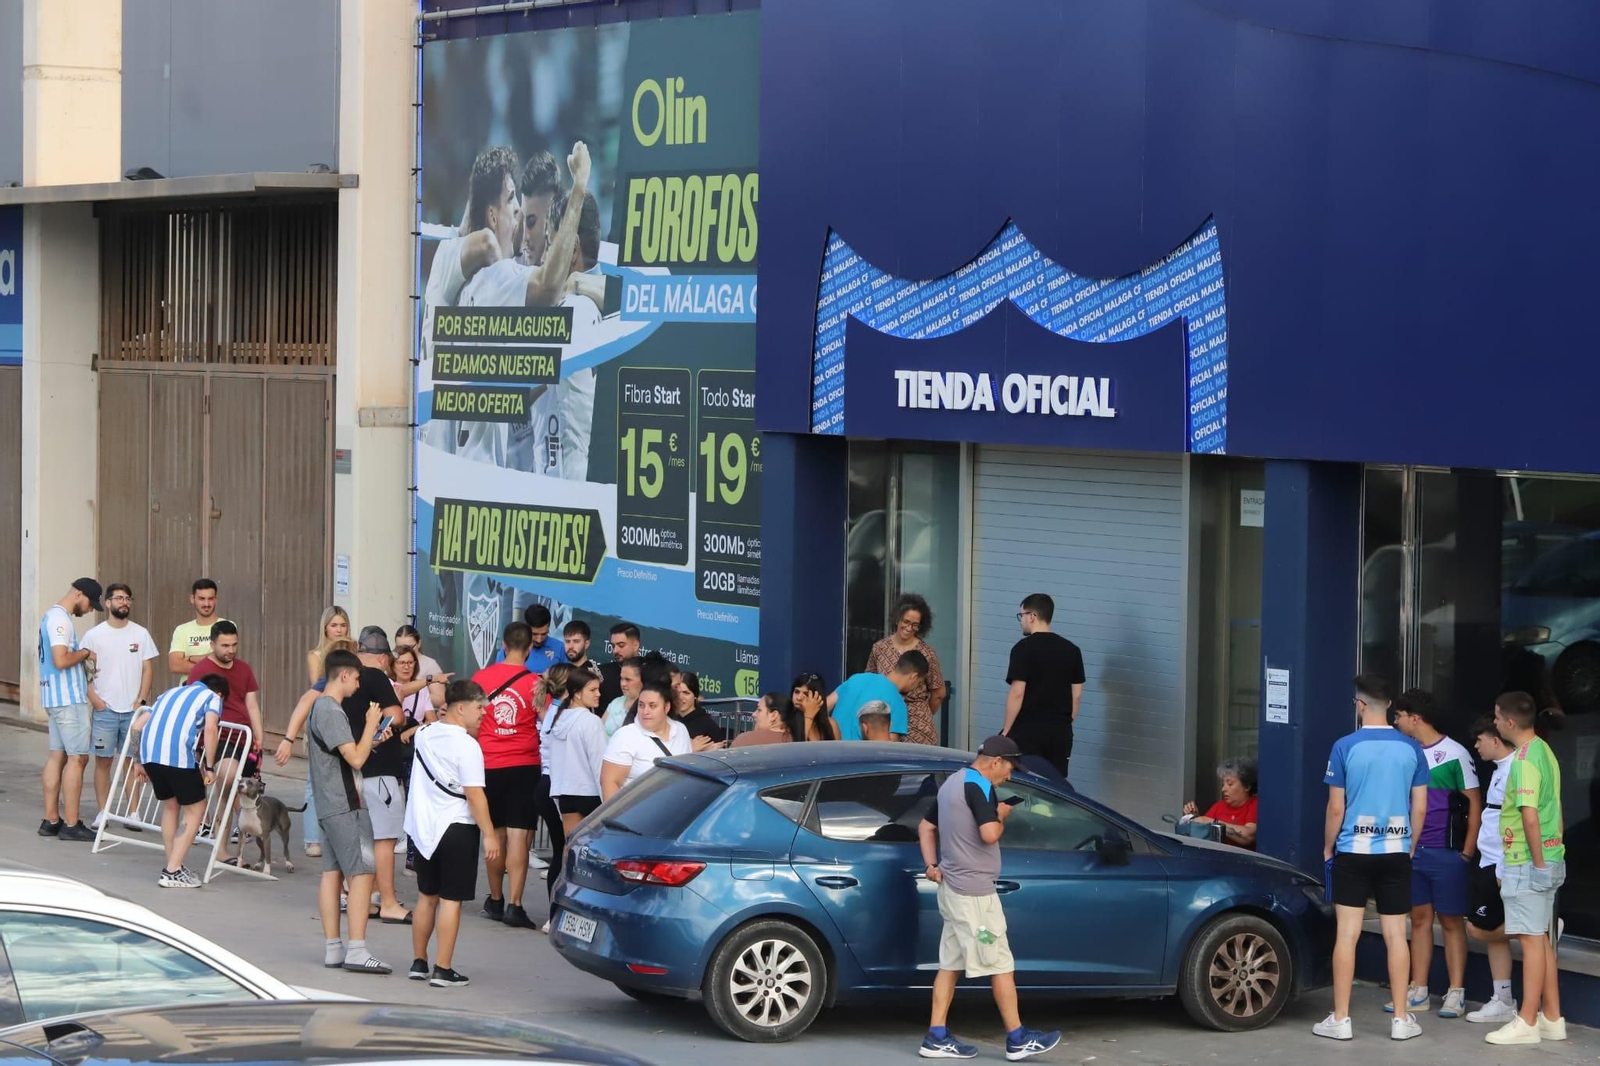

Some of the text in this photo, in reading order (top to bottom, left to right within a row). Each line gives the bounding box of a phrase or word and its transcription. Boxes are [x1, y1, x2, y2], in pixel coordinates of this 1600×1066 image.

[632, 76, 707, 147] Olin
[623, 173, 759, 263] FOROFOS
[1166, 242, 1192, 262] OFICIAL
[1193, 226, 1218, 248] MALAG
[955, 262, 978, 279] TIENDA
[978, 247, 1001, 266] OFICIAL
[837, 273, 869, 298] MALAGA CF
[959, 285, 981, 302] TIENDA
[981, 272, 1005, 290] OFICIAL
[1005, 255, 1032, 277] MALAGA
[1009, 274, 1044, 300] MALAGA CF
[1047, 273, 1070, 292] TIENDA
[1144, 283, 1169, 302] TIENDA
[1170, 266, 1196, 288] OFICIAL
[1197, 251, 1222, 273] MALAG
[625, 284, 659, 313] DEL
[663, 276, 744, 314] MÁLAGA
[865, 296, 872, 305] CF
[875, 296, 896, 312] TIENDA
[896, 282, 919, 300] OFICIAL
[900, 306, 922, 323] OFICIAL
[922, 290, 948, 311] MALAGA
[949, 285, 956, 295] CF
[1040, 298, 1048, 308] CF
[1051, 298, 1074, 316] TIENDA
[1075, 282, 1099, 302] OFICIAL
[1079, 307, 1104, 327] OFICIAL
[1104, 290, 1133, 313] MALAGA
[1134, 284, 1142, 295] CF
[962, 309, 984, 327] TIENDA
[1148, 308, 1173, 327] TIENDA
[1174, 292, 1200, 313] OFICIAL
[437, 315, 570, 341] POR SER MALAGUISTA,
[818, 316, 839, 332] OFICIAL
[925, 314, 952, 335] MALAGA
[952, 309, 960, 319] CF
[1108, 315, 1137, 338] MALAGA
[1137, 309, 1145, 320] CF
[822, 339, 843, 355] OFICIAL
[437, 353, 555, 377] TE DAMOS NUESTRA
[436, 392, 524, 415] MEJOR OFERTA
[624, 383, 681, 405] Fibra Start
[701, 387, 730, 407] Todo
[894, 370, 1115, 418] TIENDA OFICIAL
[1190, 394, 1216, 414] OFICIAL
[1193, 407, 1218, 427] OFICIAL
[548, 414, 562, 467] Olin
[1195, 420, 1221, 440] OFICIAL
[620, 428, 678, 499] 15 €
[668, 455, 685, 467] /mes
[700, 432, 760, 505] 19 €
[434, 504, 591, 575] ¡VA POR USTEDES!
[621, 526, 660, 547] 300Mb
[660, 529, 676, 539] óptica
[703, 533, 745, 556] 300Mb
[617, 567, 658, 581] Precio Definitivo
[703, 570, 736, 592] 20GB
[737, 573, 760, 585] llamadas
[428, 611, 461, 625] Patrocinador
[697, 609, 740, 623] Precio Definitivo
[428, 624, 454, 637] Oficial del
[678, 654, 691, 666] en:
